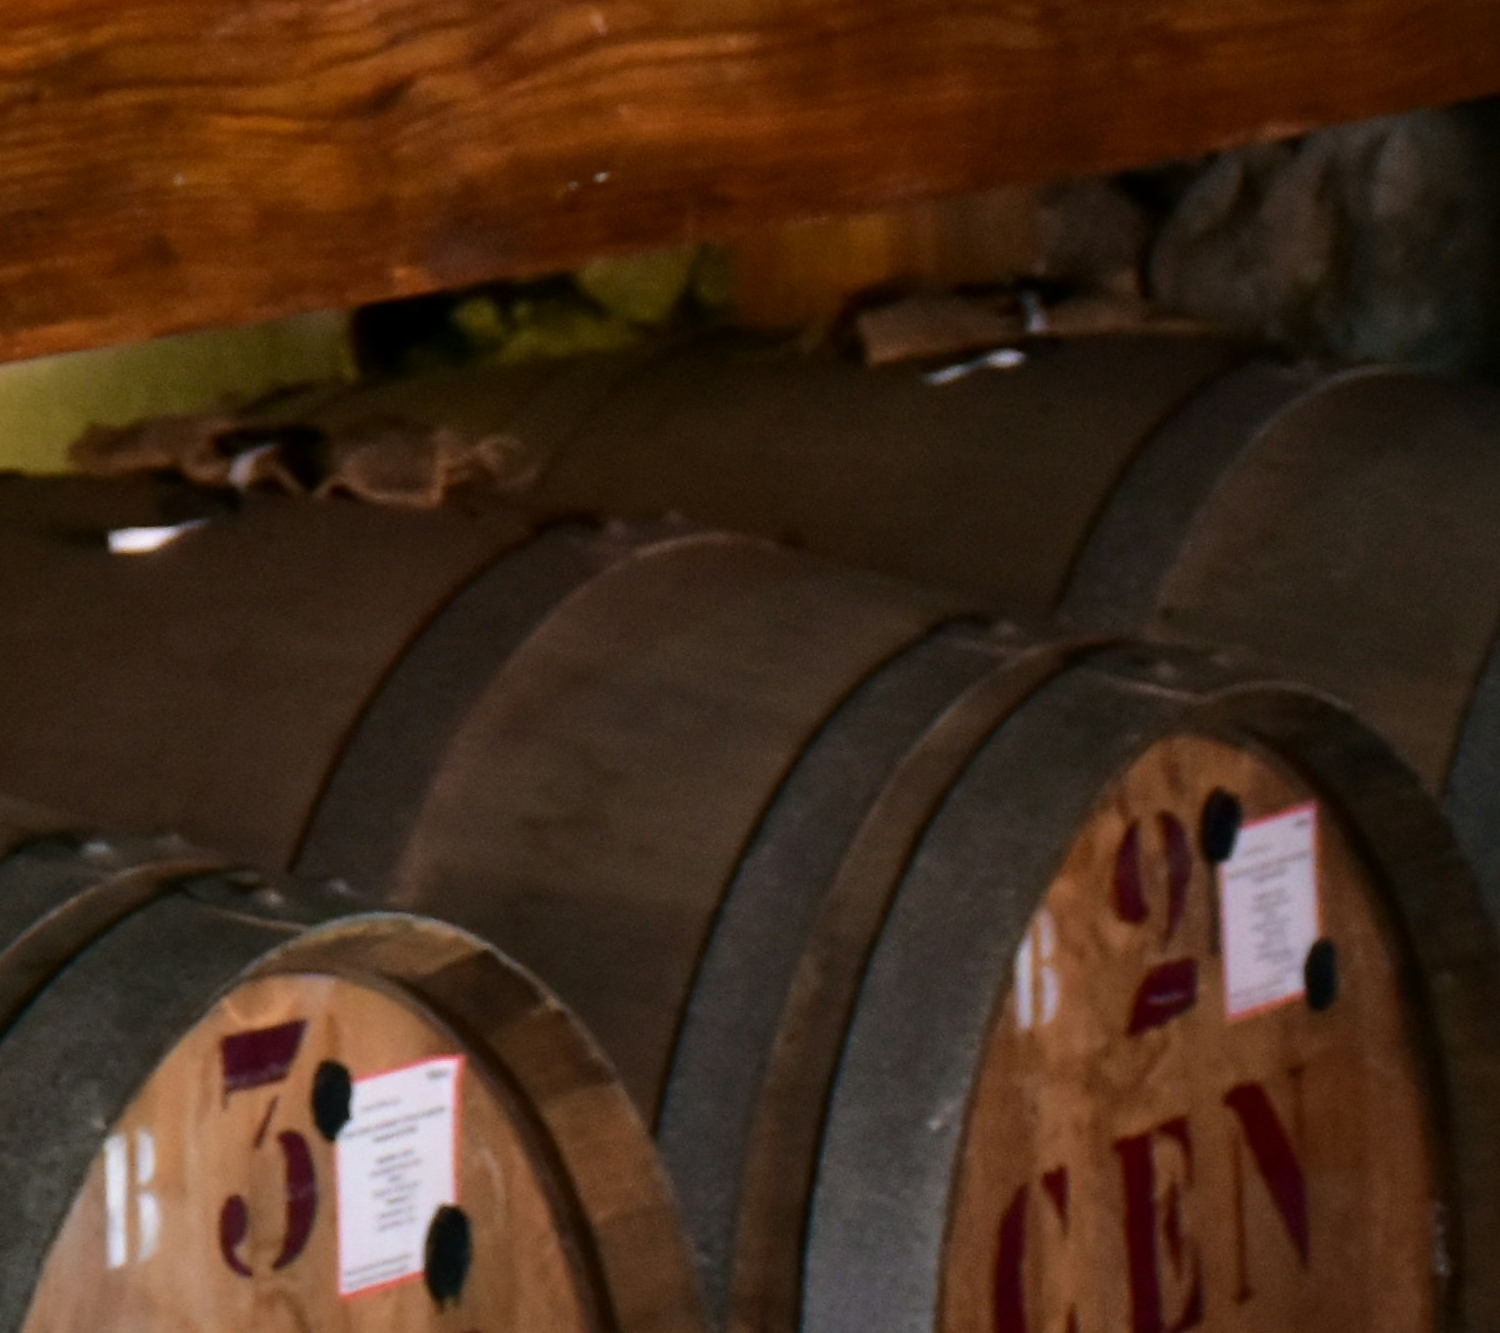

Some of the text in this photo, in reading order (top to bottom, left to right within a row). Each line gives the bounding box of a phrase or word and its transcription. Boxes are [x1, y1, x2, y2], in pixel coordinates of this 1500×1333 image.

[1014, 909, 1061, 1033] B
[1110, 809, 1200, 1039] 9
[102, 1130, 162, 1270] B
[992, 1068, 1312, 1333] CEN
